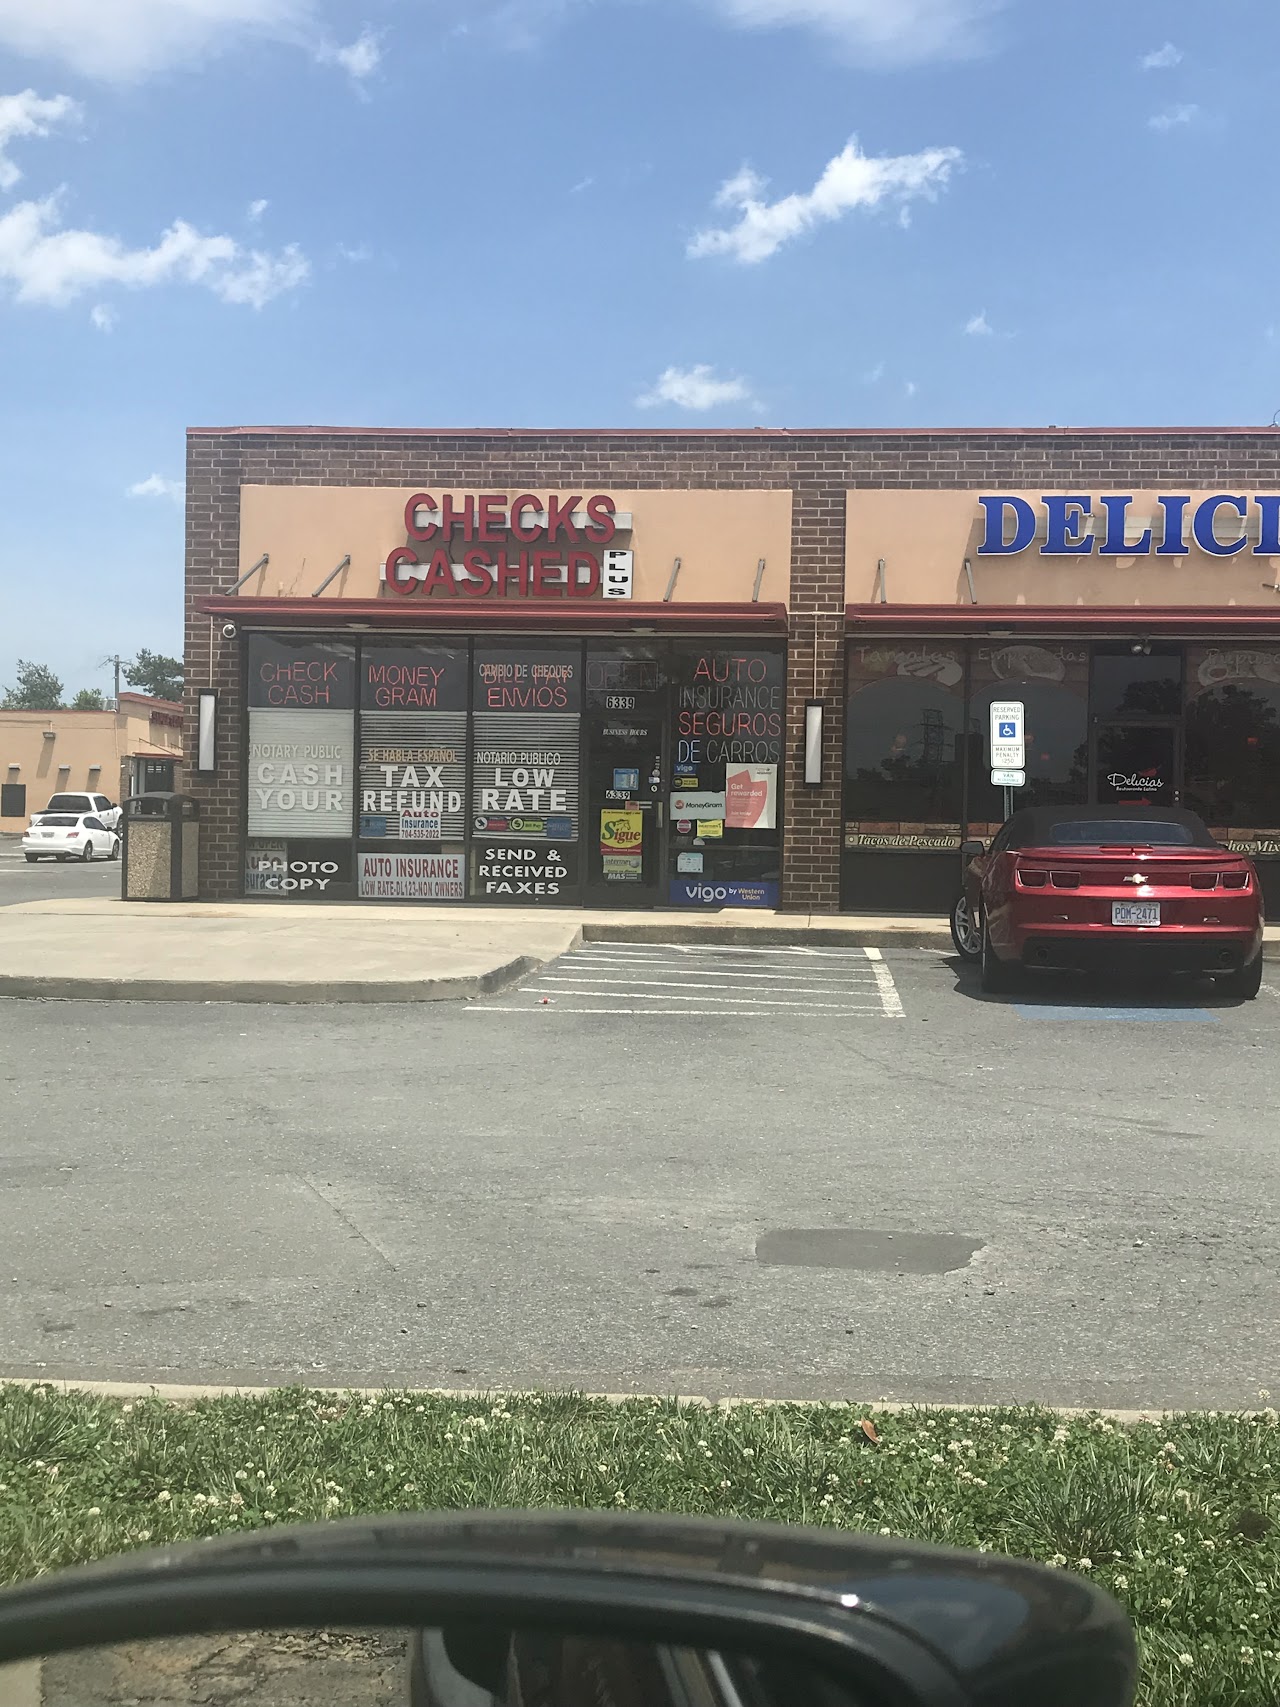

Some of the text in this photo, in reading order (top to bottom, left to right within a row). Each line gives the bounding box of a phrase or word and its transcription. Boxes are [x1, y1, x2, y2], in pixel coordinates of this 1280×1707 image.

[404, 493, 616, 543] CHECKS
[977, 494, 1280, 556] DELICI
[385, 547, 600, 597] CASHED
[608, 551, 628, 596] PLUS
[856, 646, 956, 663] Tamales
[260, 662, 338, 681] CHECK
[369, 665, 445, 686] MONEY
[479, 664, 573, 678] CAMBIO DE CHEQUES
[694, 658, 766, 682] AUTO
[268, 685, 330, 704] CASH
[375, 687, 436, 707] GRAM
[488, 687, 567, 707] ENVIOS
[607, 697, 634, 709] 6339
[680, 686, 780, 709] INSURANCE
[679, 711, 780, 736] SEGUROS
[252, 744, 342, 758] NOTARY PUBLIC
[368, 749, 379, 761] SE
[383, 749, 413, 762] HABLA
[476, 752, 561, 765] NOTARIO PUBLICO
[678, 740, 780, 763] DE CARROS
[257, 762, 343, 785] CASH
[380, 765, 444, 788] TAX
[495, 768, 555, 787] LOW
[1107, 773, 1164, 787] Delicias
[255, 788, 343, 811] YOUR
[363, 790, 461, 812] REFUND
[482, 789, 567, 811] RATE
[607, 791, 629, 799] 6339
[402, 810, 439, 818] Auto
[402, 819, 438, 829] Insurance
[602, 820, 641, 844] Sigue
[401, 829, 439, 839] 704-535-2022
[858, 835, 955, 847] Tacos de Pescado
[485, 848, 562, 861] SEND &
[1227, 840, 1250, 851] hos
[258, 861, 339, 874] PHOTO
[363, 858, 459, 878] AUTO INSURANCE
[479, 865, 568, 878] RECEIVED
[265, 878, 330, 890] COPY
[362, 880, 375, 895] LOW
[434, 881, 463, 898] OWNERS
[486, 881, 560, 894] FAXES
[686, 883, 727, 902] vigo
[728, 887, 738, 895] by
[1115, 907, 1158, 919] PDM-2471
